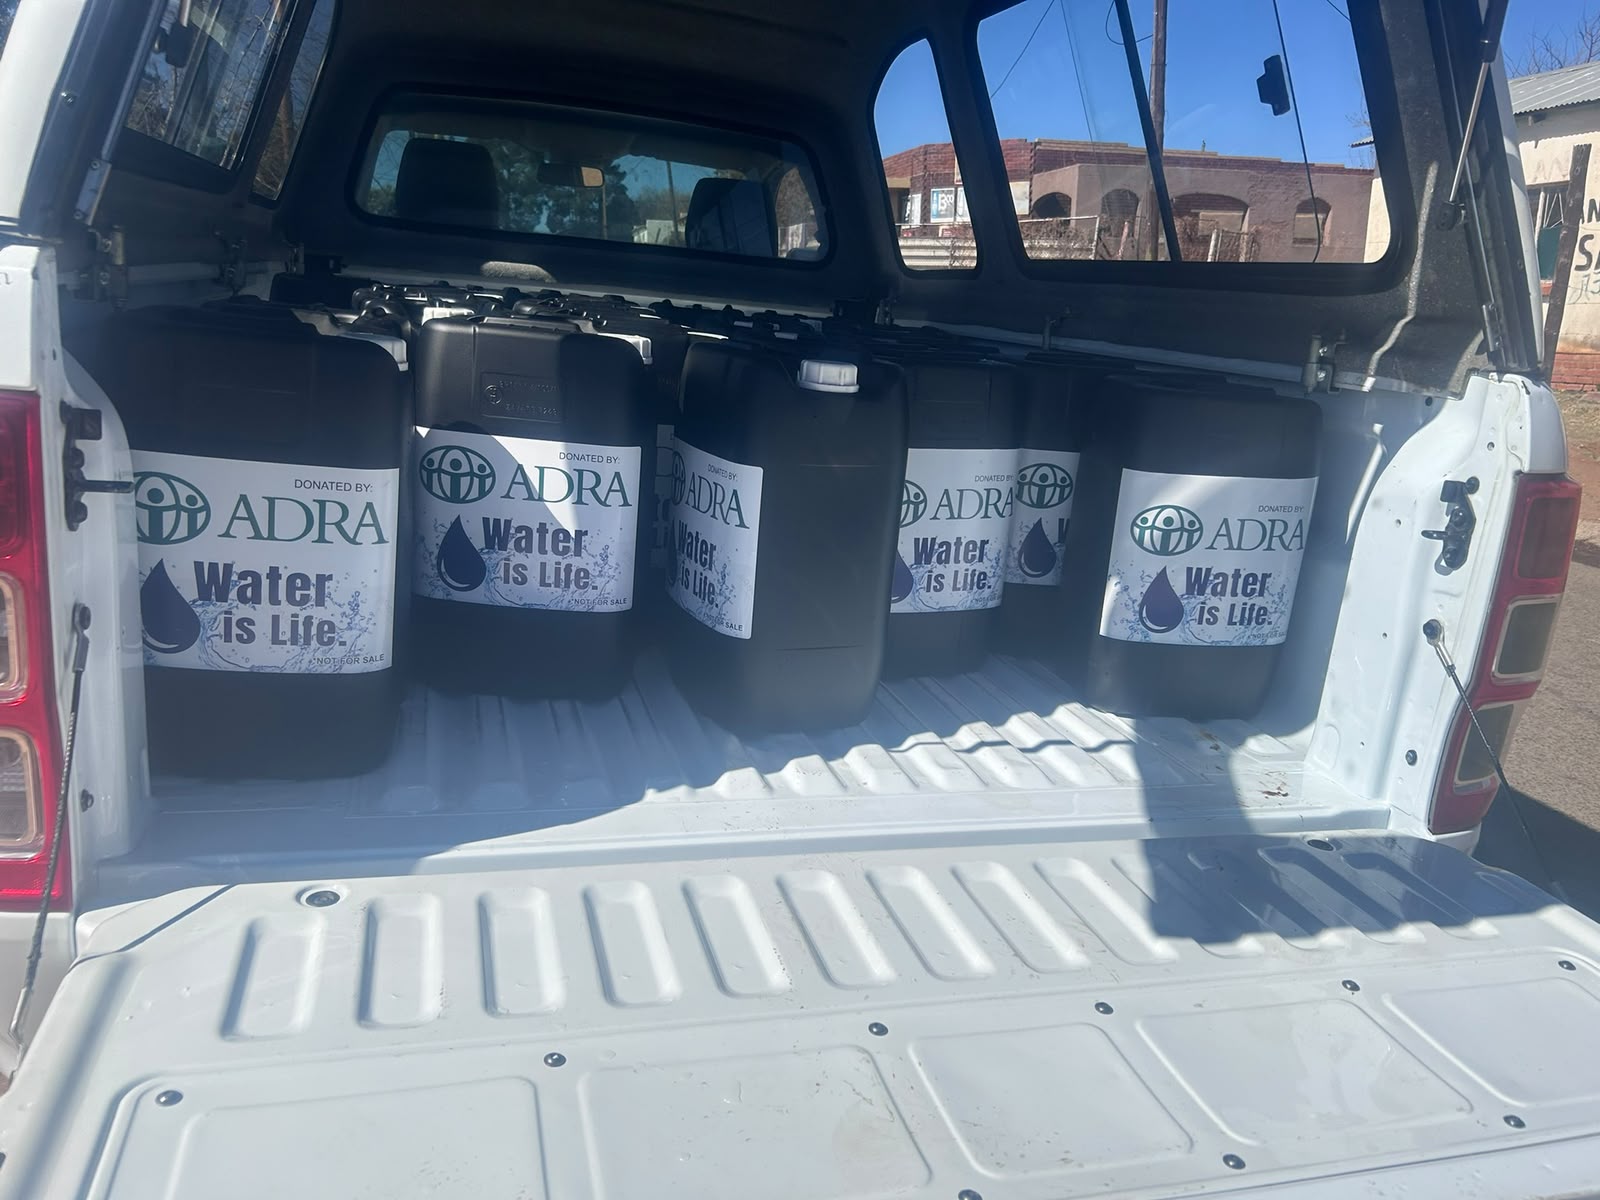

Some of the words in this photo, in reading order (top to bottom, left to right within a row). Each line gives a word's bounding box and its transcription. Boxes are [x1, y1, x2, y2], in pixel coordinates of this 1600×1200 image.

[559, 452, 604, 464] DONATED
[605, 455, 621, 465] BY:
[708, 463, 728, 479] DONATED
[295, 479, 352, 492] DONATED
[355, 483, 373, 493] BY:
[500, 463, 633, 508] ADRA
[974, 474, 1005, 483] DONATED
[685, 471, 750, 530] ADRA
[929, 487, 1014, 521] ADRA
[1258, 505, 1293, 513] DONATED
[217, 493, 390, 545] ADRA
[1204, 517, 1305, 552] ADRA
[482, 516, 589, 557] Water
[677, 519, 717, 571] Water
[913, 536, 990, 566] Water
[193, 560, 334, 608] Water
[502, 558, 529, 586] is
[539, 561, 599, 591] Life.
[681, 561, 690, 591] is
[693, 572, 719, 609] Life.
[925, 570, 945, 593] is
[952, 568, 992, 592] Life.
[1185, 566, 1273, 598] Water
[592, 598, 609, 606] FOR
[610, 597, 628, 606] SALE
[1197, 601, 1220, 626] is
[1227, 602, 1273, 627] Life.
[223, 610, 256, 643] is
[271, 614, 347, 647] Life.
[725, 621, 744, 632] SALE
[340, 657, 360, 665] FOR
[362, 653, 385, 664] SALE
